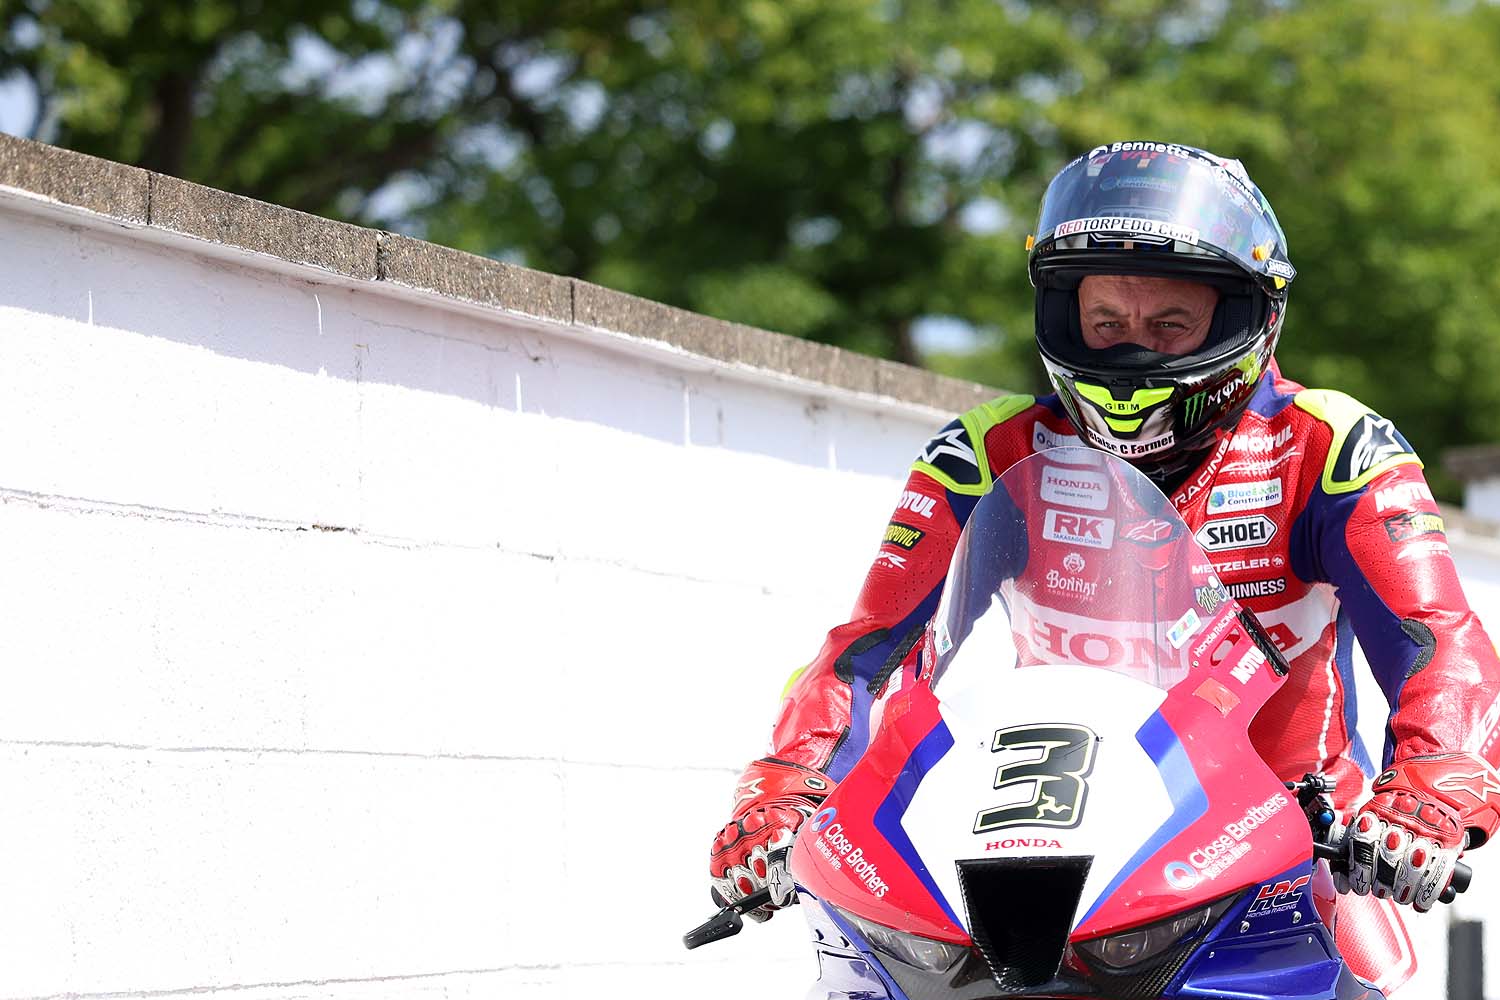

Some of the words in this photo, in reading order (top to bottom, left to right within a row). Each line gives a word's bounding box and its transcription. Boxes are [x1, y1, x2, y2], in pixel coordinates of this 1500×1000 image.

[1111, 141, 1190, 160] Bennetts
[1057, 218, 1195, 242] REDTORPEDO.COM
[1119, 443, 1129, 455] C
[1130, 433, 1175, 455] Farmer
[1227, 424, 1294, 453] MOTUL
[1046, 476, 1103, 492] HONDA
[1053, 513, 1105, 540] RK
[1206, 520, 1267, 546] SHOEI
[1191, 557, 1271, 575] METZELER
[1229, 645, 1267, 685] MOTU
[972, 722, 1100, 835] 3
[1188, 833, 1234, 869] Close
[1224, 792, 1289, 841] Brothers
[984, 838, 1063, 851] HONDA
[824, 822, 853, 856] Close
[845, 846, 890, 898] Brothers
[828, 853, 842, 871] Hire
[1248, 874, 1311, 913] HRC
[1270, 902, 1298, 914] RACING
